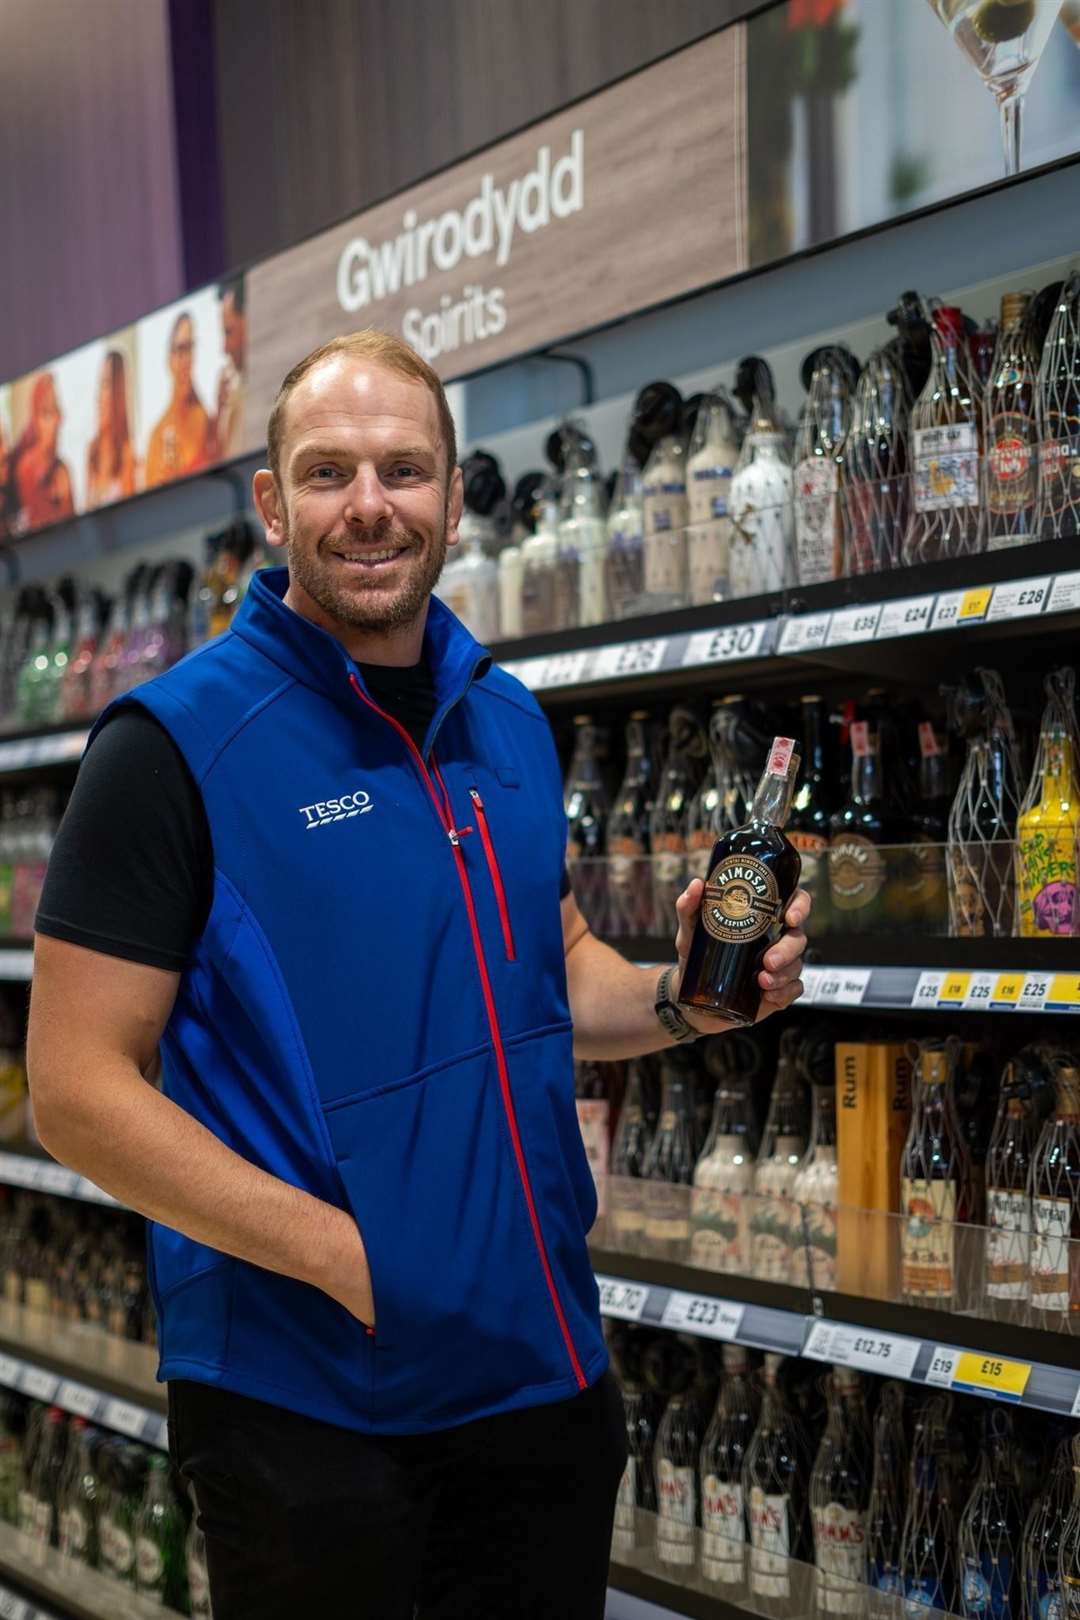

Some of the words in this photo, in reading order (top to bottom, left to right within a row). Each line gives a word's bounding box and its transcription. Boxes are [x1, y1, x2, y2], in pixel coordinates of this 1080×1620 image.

[337, 129, 584, 312] Gwirodydd
[402, 285, 507, 360] Spirits
[1018, 590, 1044, 605] £28
[905, 607, 928, 622] £24
[709, 628, 755, 658] £30
[299, 790, 369, 821] TESCO
[719, 867, 767, 894] MIMOSA
[919, 985, 938, 998] £25
[970, 985, 991, 998] £25
[1023, 983, 1046, 996] £25
[842, 1055, 857, 1109] Rum
[686, 1299, 719, 1325] £23
[853, 1337, 892, 1359] £12.75
[932, 1358, 953, 1374] £19
[981, 1360, 1003, 1377] £15
